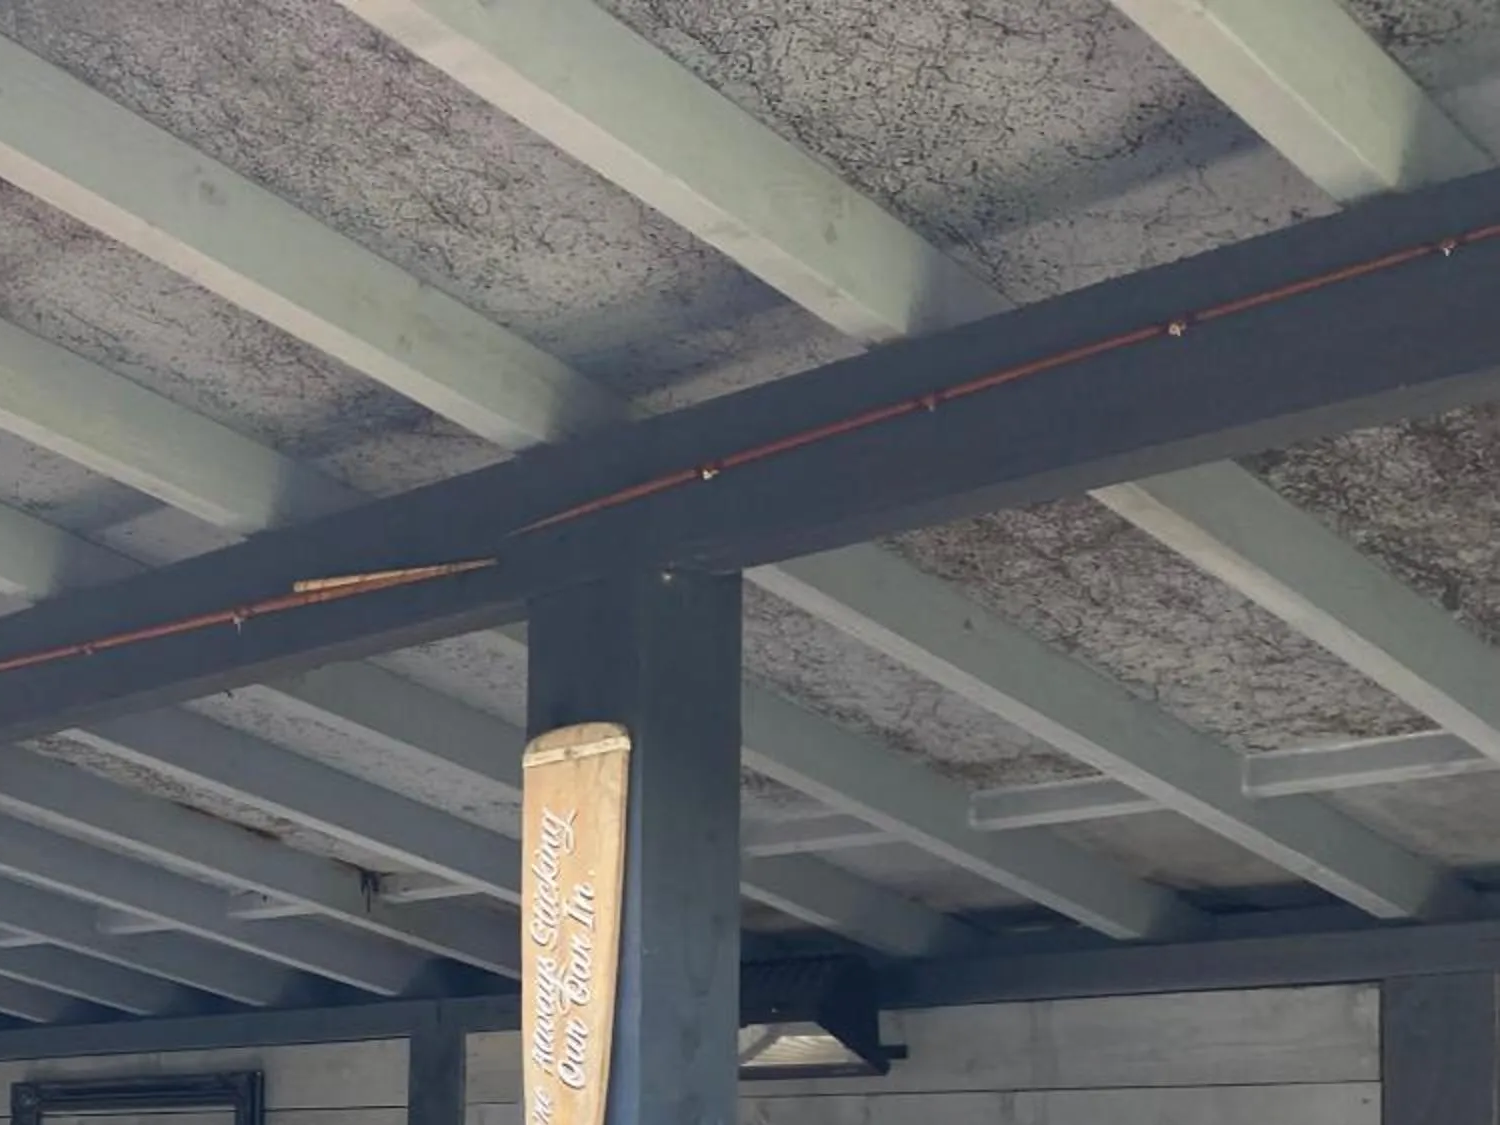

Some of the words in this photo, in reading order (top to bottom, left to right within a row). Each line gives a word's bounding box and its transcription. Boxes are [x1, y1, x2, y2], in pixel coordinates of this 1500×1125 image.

[530, 807, 577, 953] Sticking
[531, 957, 568, 1078] Always
[564, 937, 593, 1007] Oar
[557, 1025, 590, 1091] Our
